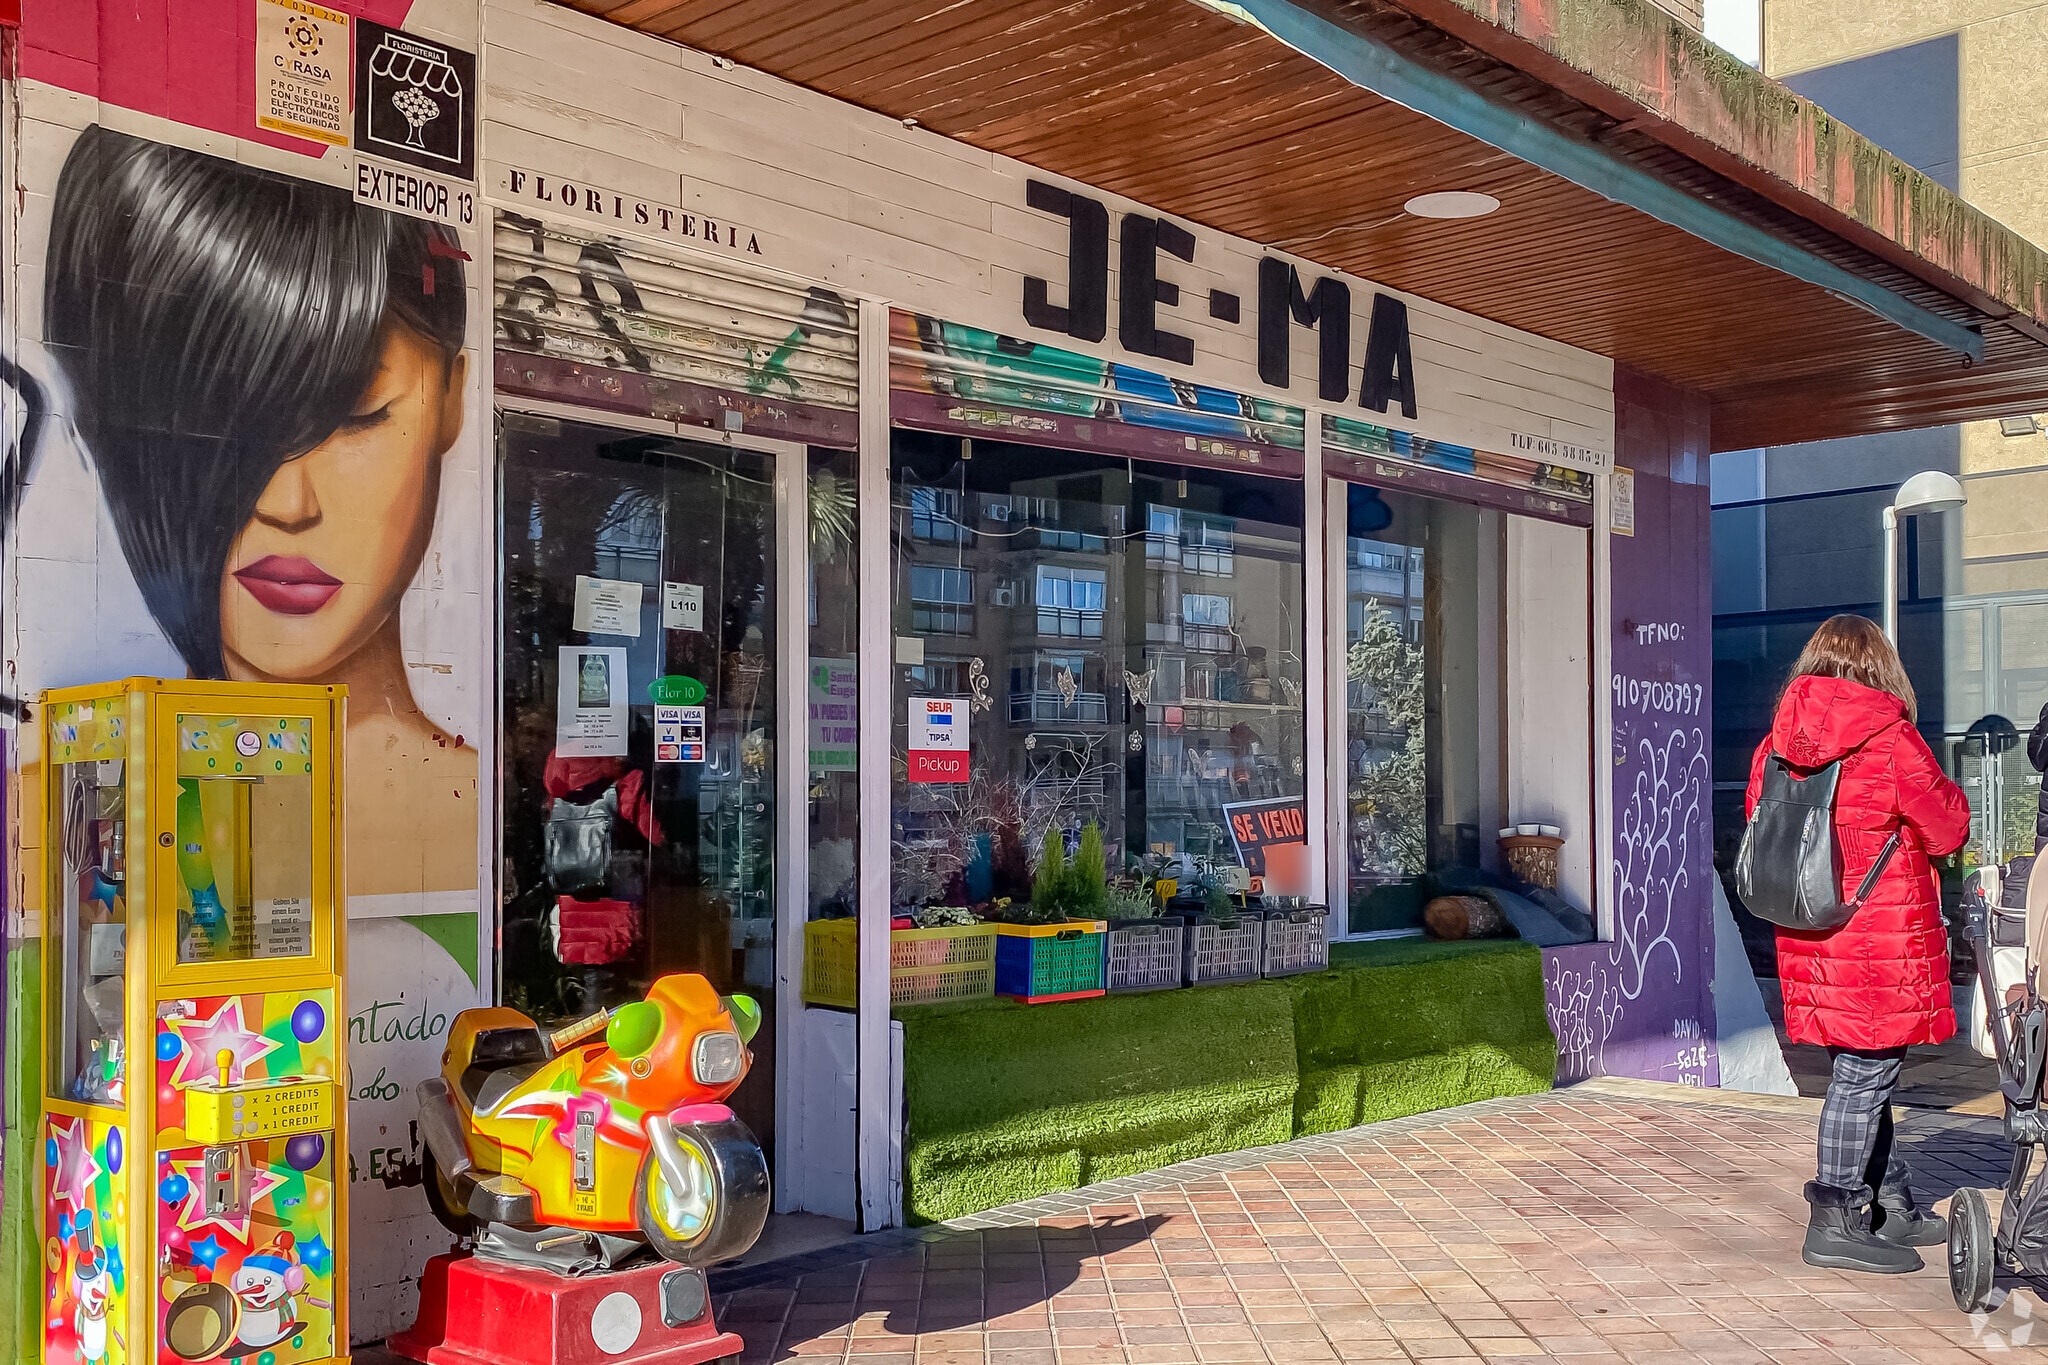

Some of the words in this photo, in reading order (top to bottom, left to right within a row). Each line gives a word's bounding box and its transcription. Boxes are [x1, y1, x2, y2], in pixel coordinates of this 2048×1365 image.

[292, 2, 315, 15] 033
[323, 11, 345, 25] 222
[274, 55, 332, 81] CYRASA
[270, 79, 340, 104] PROTEGIDO
[271, 89, 291, 101] CON
[294, 94, 340, 113] SISTEMAS
[271, 98, 340, 122] ELECTRÓNICOS
[271, 107, 284, 117] DE
[287, 110, 340, 131] SEGURIDAD
[358, 163, 448, 217] EXTERIOR
[457, 191, 473, 224] 13
[509, 169, 762, 255] FLORISTERIA
[1023, 178, 1418, 420] JE-MA
[671, 600, 697, 612] L110
[1636, 622, 1685, 645] TFNO:
[657, 684, 682, 699] Flor
[684, 686, 695, 699] 10
[1612, 673, 1703, 717] 910708797
[660, 710, 679, 719] VISA
[683, 711, 702, 719] VISA
[926, 701, 953, 713] SEUR
[928, 732, 951, 742] TIPSA
[918, 757, 960, 774] Pickup
[1233, 813, 1258, 843] SE
[265, 1094, 271, 1103] 2
[275, 1088, 319, 1102] CREDITS
[272, 1107, 278, 1116] 1
[281, 1102, 320, 1115] CREDIT
[272, 1120, 278, 1129] 1
[281, 1115, 320, 1128] CREDIT
